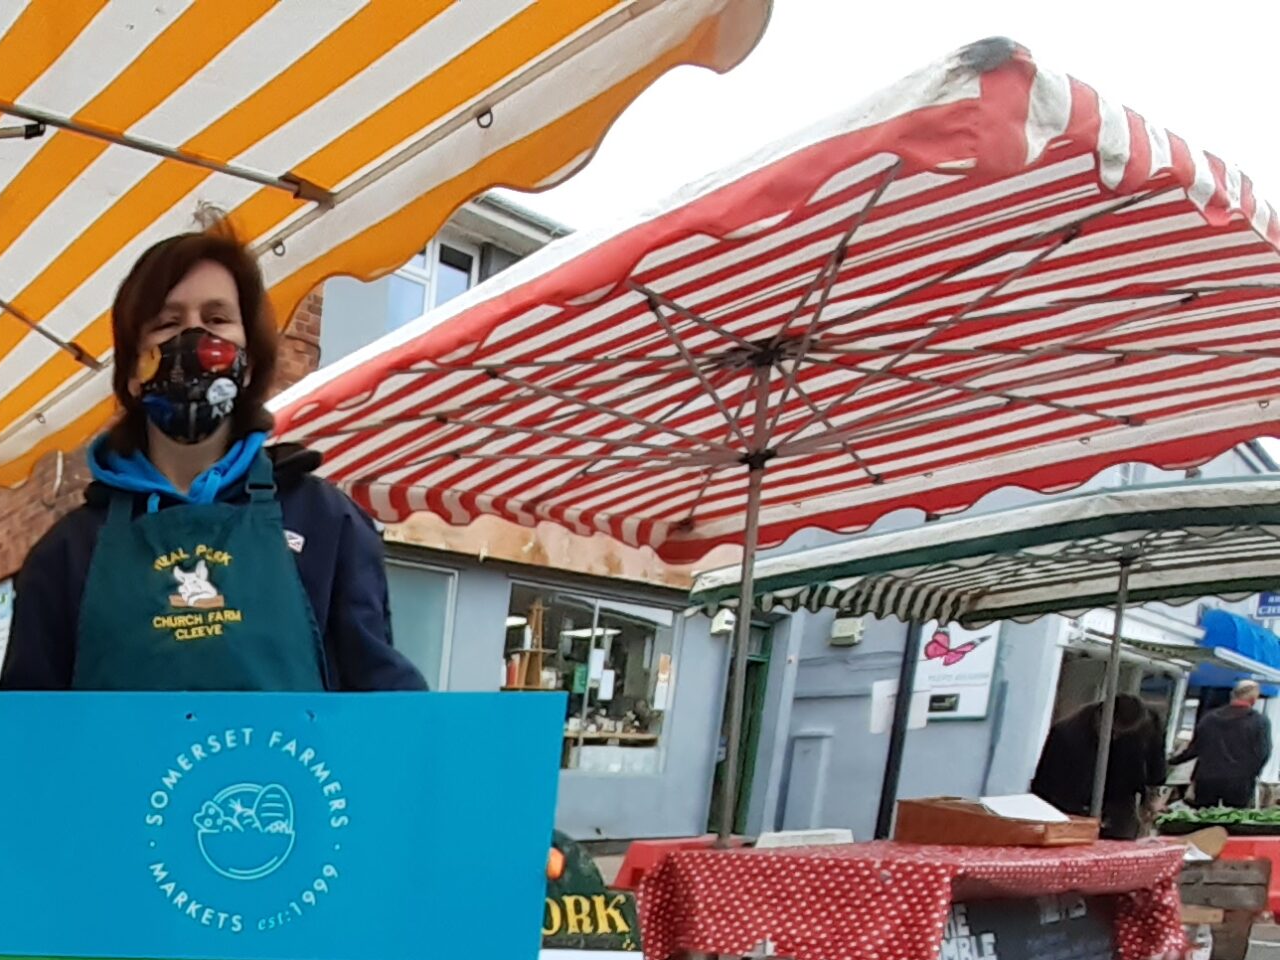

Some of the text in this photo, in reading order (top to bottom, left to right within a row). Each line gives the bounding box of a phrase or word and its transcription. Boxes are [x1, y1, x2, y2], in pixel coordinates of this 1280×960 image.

[152, 609, 242, 628] CHURCH FARM
[175, 624, 223, 640] CLEEVE
[146, 728, 349, 828] SOMERSET FARMERS
[150, 862, 243, 932] MARKETS
[541, 894, 631, 936] ORK
